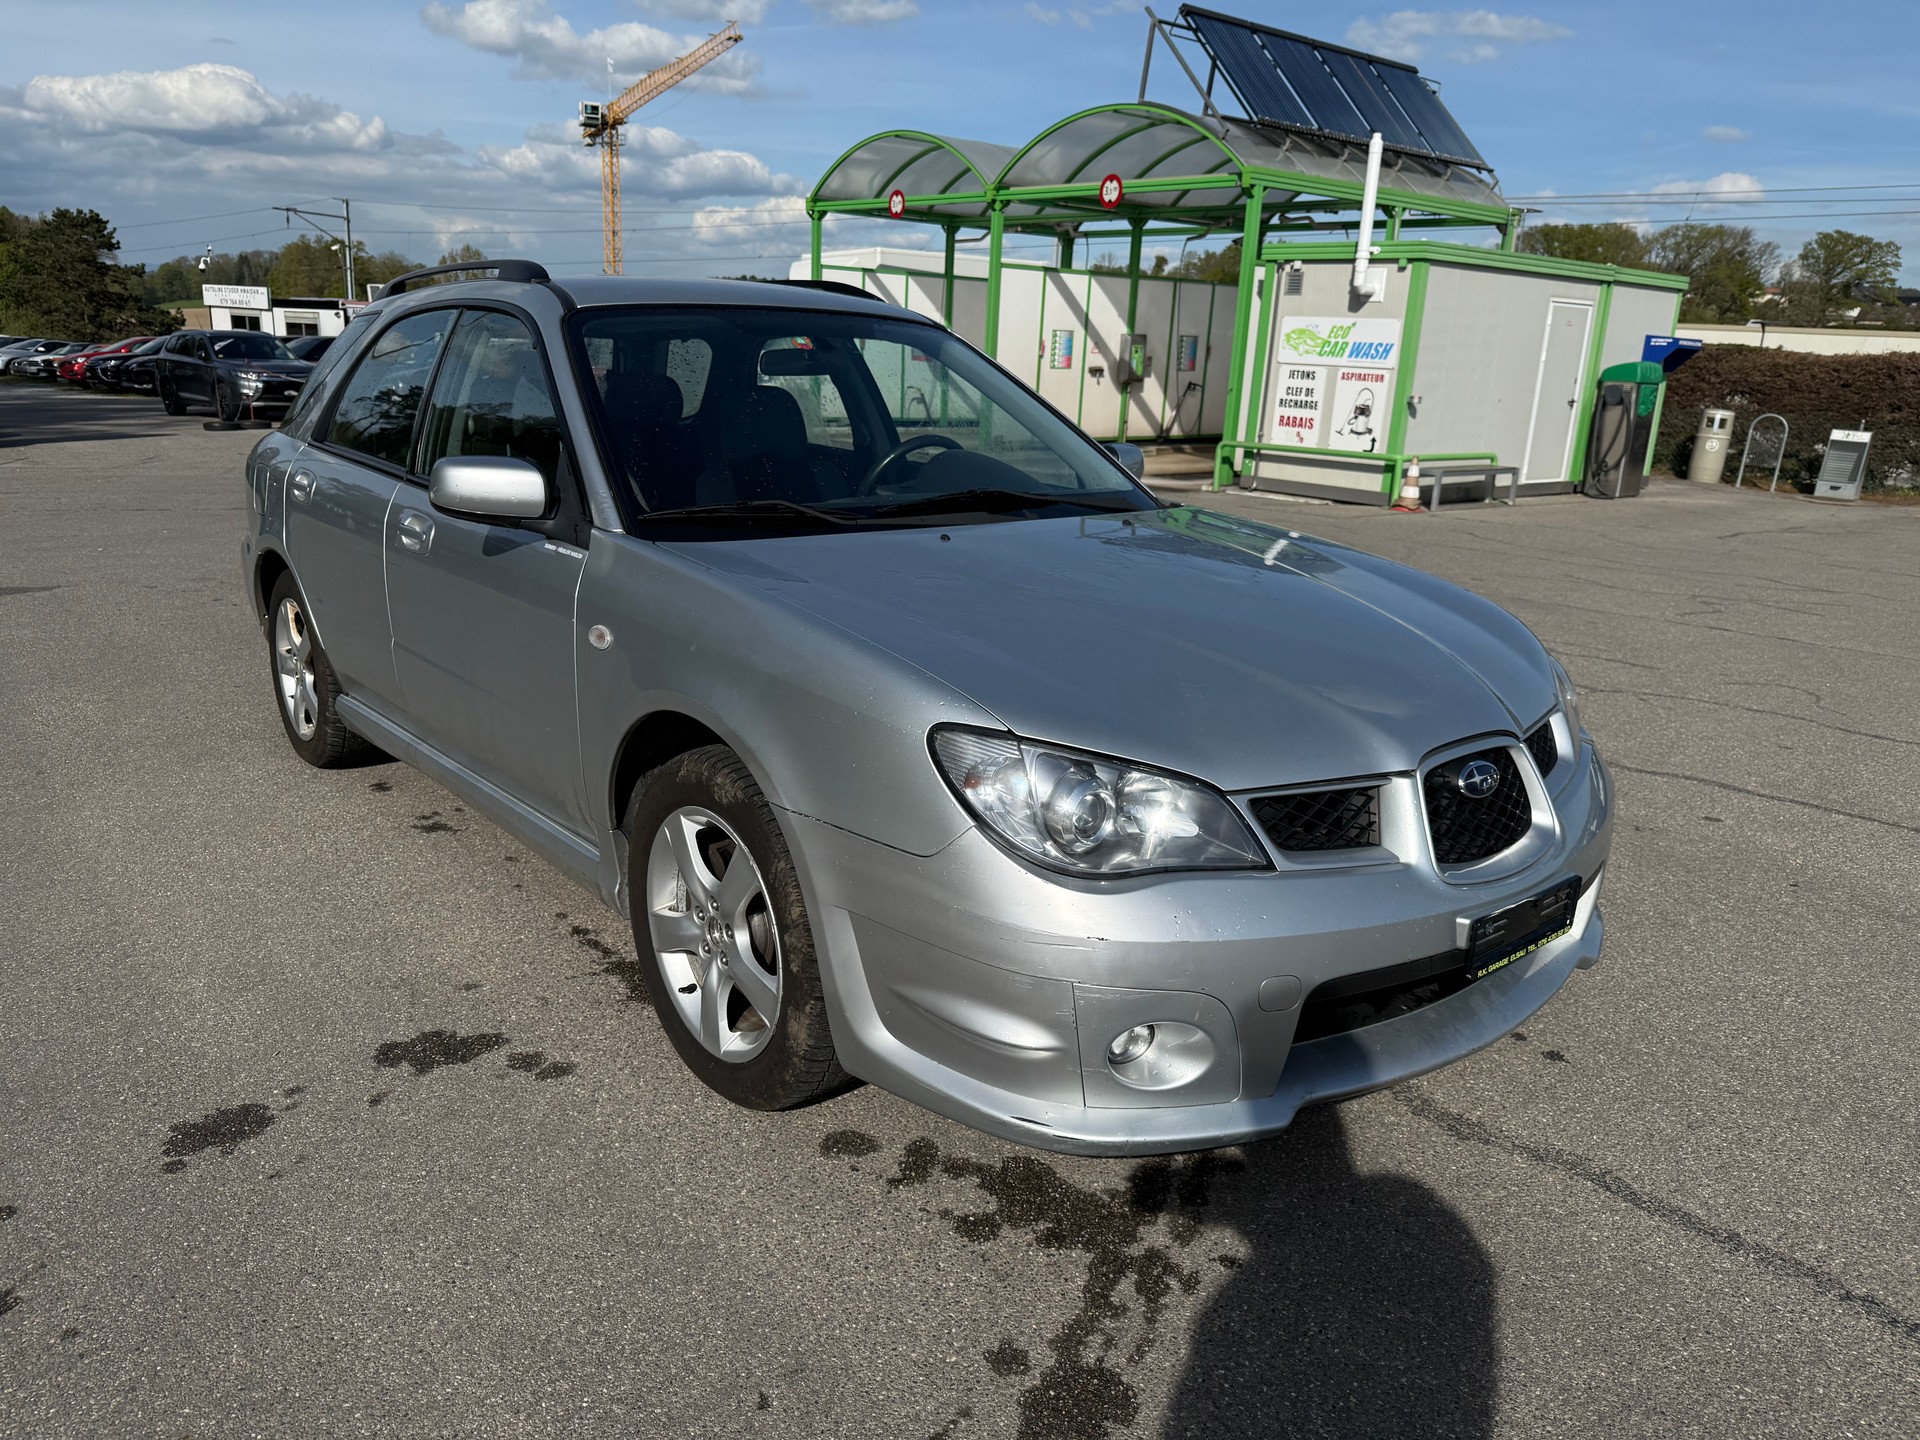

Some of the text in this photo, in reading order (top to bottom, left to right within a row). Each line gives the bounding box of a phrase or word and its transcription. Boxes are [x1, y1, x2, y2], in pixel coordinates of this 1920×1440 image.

[1327, 325, 1352, 340] ECO
[1318, 340, 1394, 360] CAR WASH
[1288, 369, 1316, 380] JETONS
[1340, 371, 1385, 383] ASPIRATEUR
[1285, 386, 1315, 398] CLEF DE
[1278, 398, 1319, 411] RECHARGE
[1278, 415, 1315, 430] RABAIS
[1488, 957, 1509, 973] GARAGE
